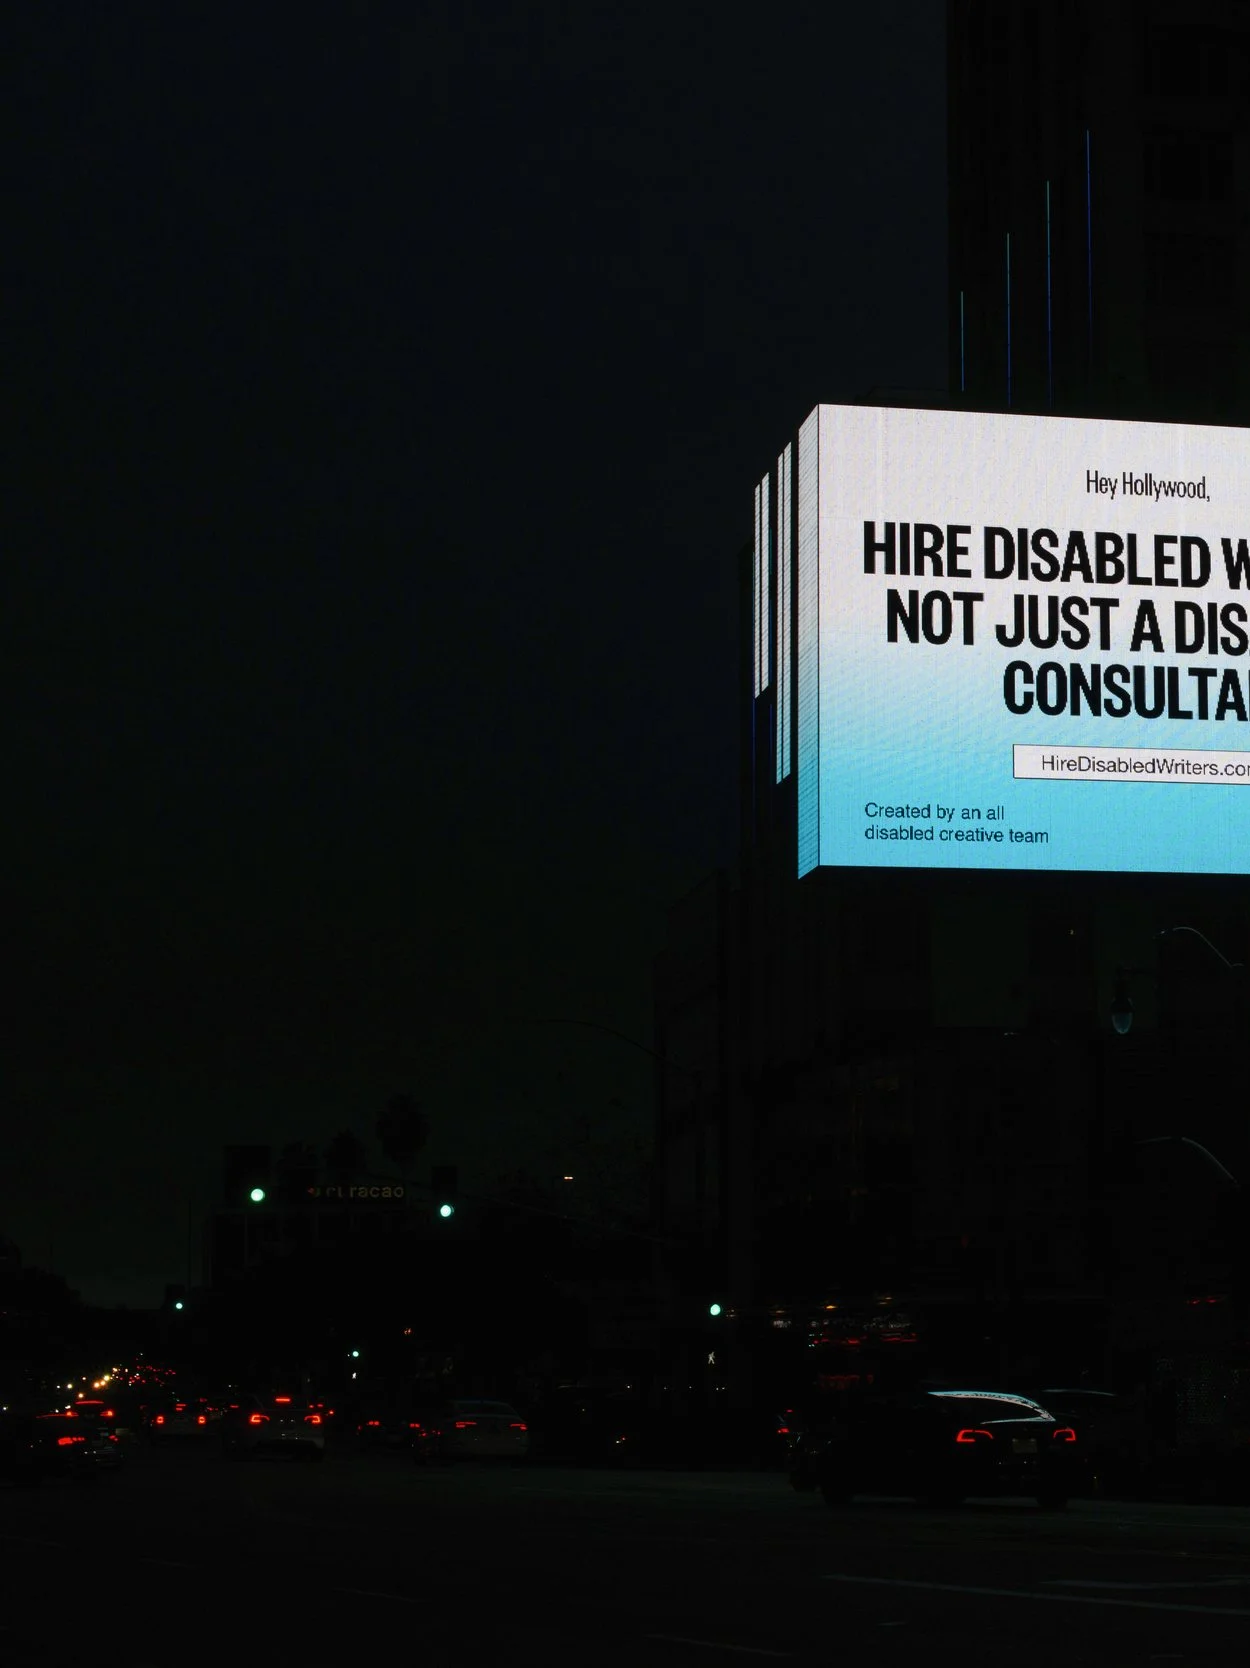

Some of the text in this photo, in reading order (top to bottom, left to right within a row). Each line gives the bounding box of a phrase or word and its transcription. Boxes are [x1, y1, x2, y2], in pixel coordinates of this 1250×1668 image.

[1086, 470, 1211, 502] Hey Hollywood,
[864, 520, 972, 578] HIRE
[984, 525, 1211, 588] DISABLED
[887, 588, 984, 645] NOT
[995, 593, 1119, 652] JUST
[1130, 598, 1165, 653] A
[864, 801, 1004, 823] Created by an all
[864, 824, 1049, 844] disabled creative team
